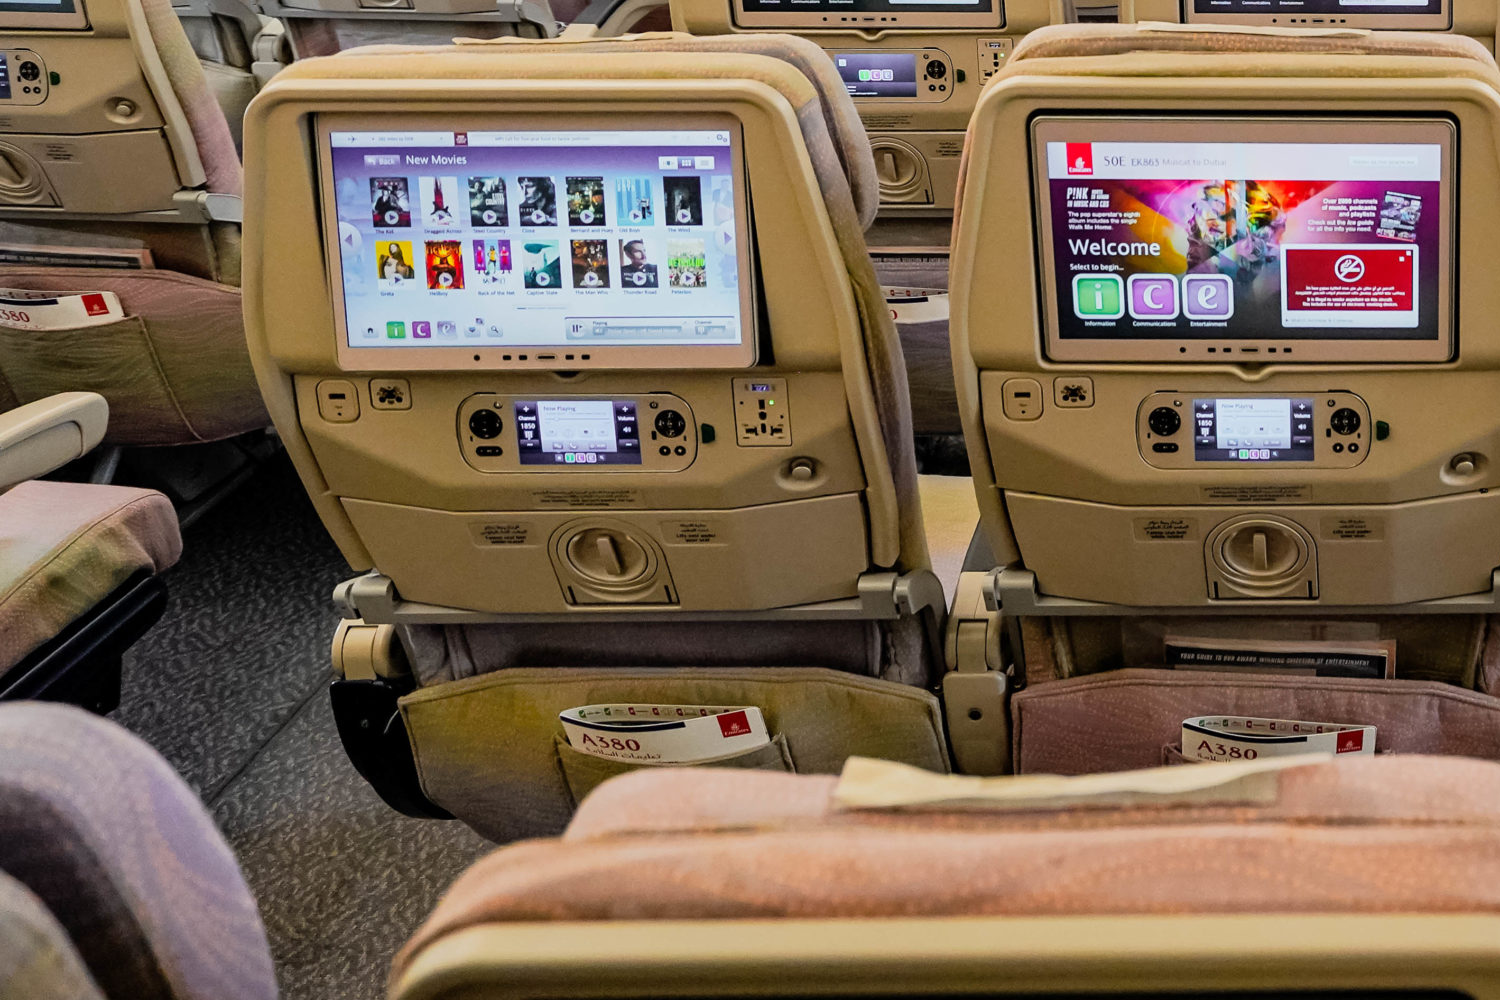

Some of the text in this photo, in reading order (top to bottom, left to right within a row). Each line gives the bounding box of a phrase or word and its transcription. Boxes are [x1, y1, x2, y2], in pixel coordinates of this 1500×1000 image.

[406, 155, 467, 165] New Movies
[1104, 156, 1126, 167] 50E
[1066, 187, 1089, 200] P!NK
[1068, 238, 1161, 256] Welcome
[1070, 263, 1089, 271] Select
[1094, 283, 1103, 310] i
[1197, 284, 1218, 310] e
[583, 733, 641, 751] A380
[1198, 740, 1258, 760] A380
